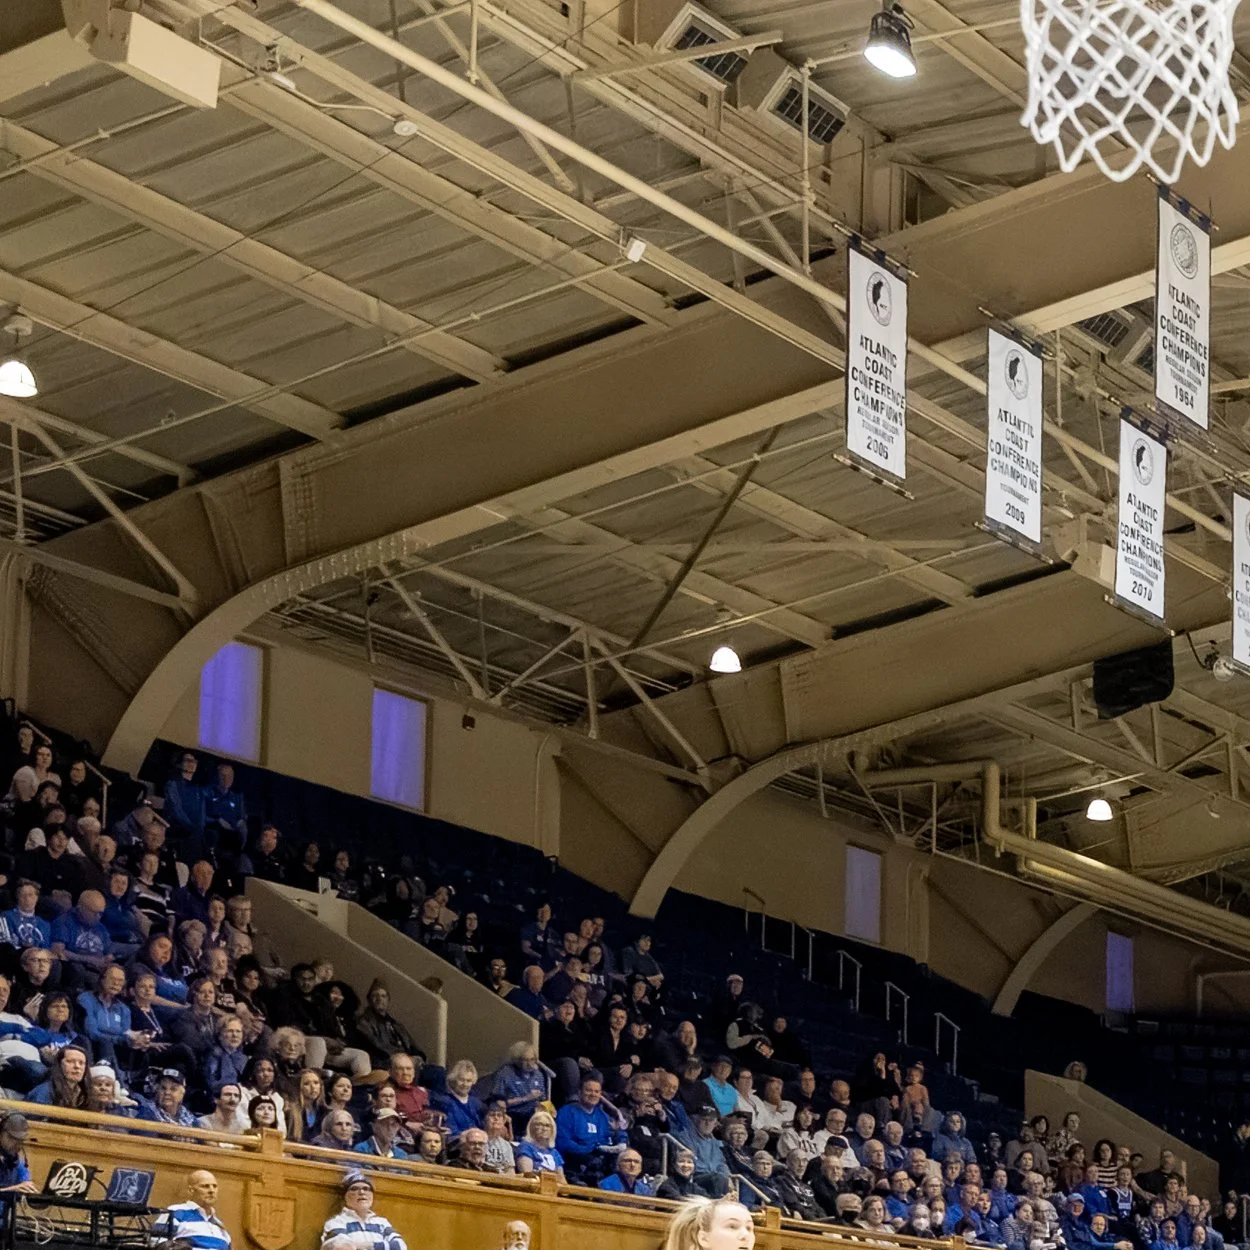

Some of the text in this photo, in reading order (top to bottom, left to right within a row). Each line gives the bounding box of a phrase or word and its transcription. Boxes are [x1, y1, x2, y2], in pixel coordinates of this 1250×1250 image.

[1168, 283, 1200, 319] ATLANTIC
[1172, 305, 1196, 333] COAST
[860, 334, 897, 368] ATLANTIC
[1160, 315, 1207, 360] CONFERENCE
[865, 356, 892, 383] COAST
[1162, 336, 1206, 378] CHAMPIONS
[851, 366, 905, 409] CONFERENCE
[1174, 384, 1194, 409] 1964
[854, 387, 903, 427] CHAMPIONS
[997, 408, 1034, 438] ATLANTIC
[1005, 428, 1028, 452] COAST
[990, 439, 1039, 478] CONFERENCE
[990, 458, 1038, 493] CHAMPIONS
[1005, 502, 1025, 525] 2009
[1121, 539, 1162, 572] CHAMPIONS
[1131, 581, 1152, 602] 2010
